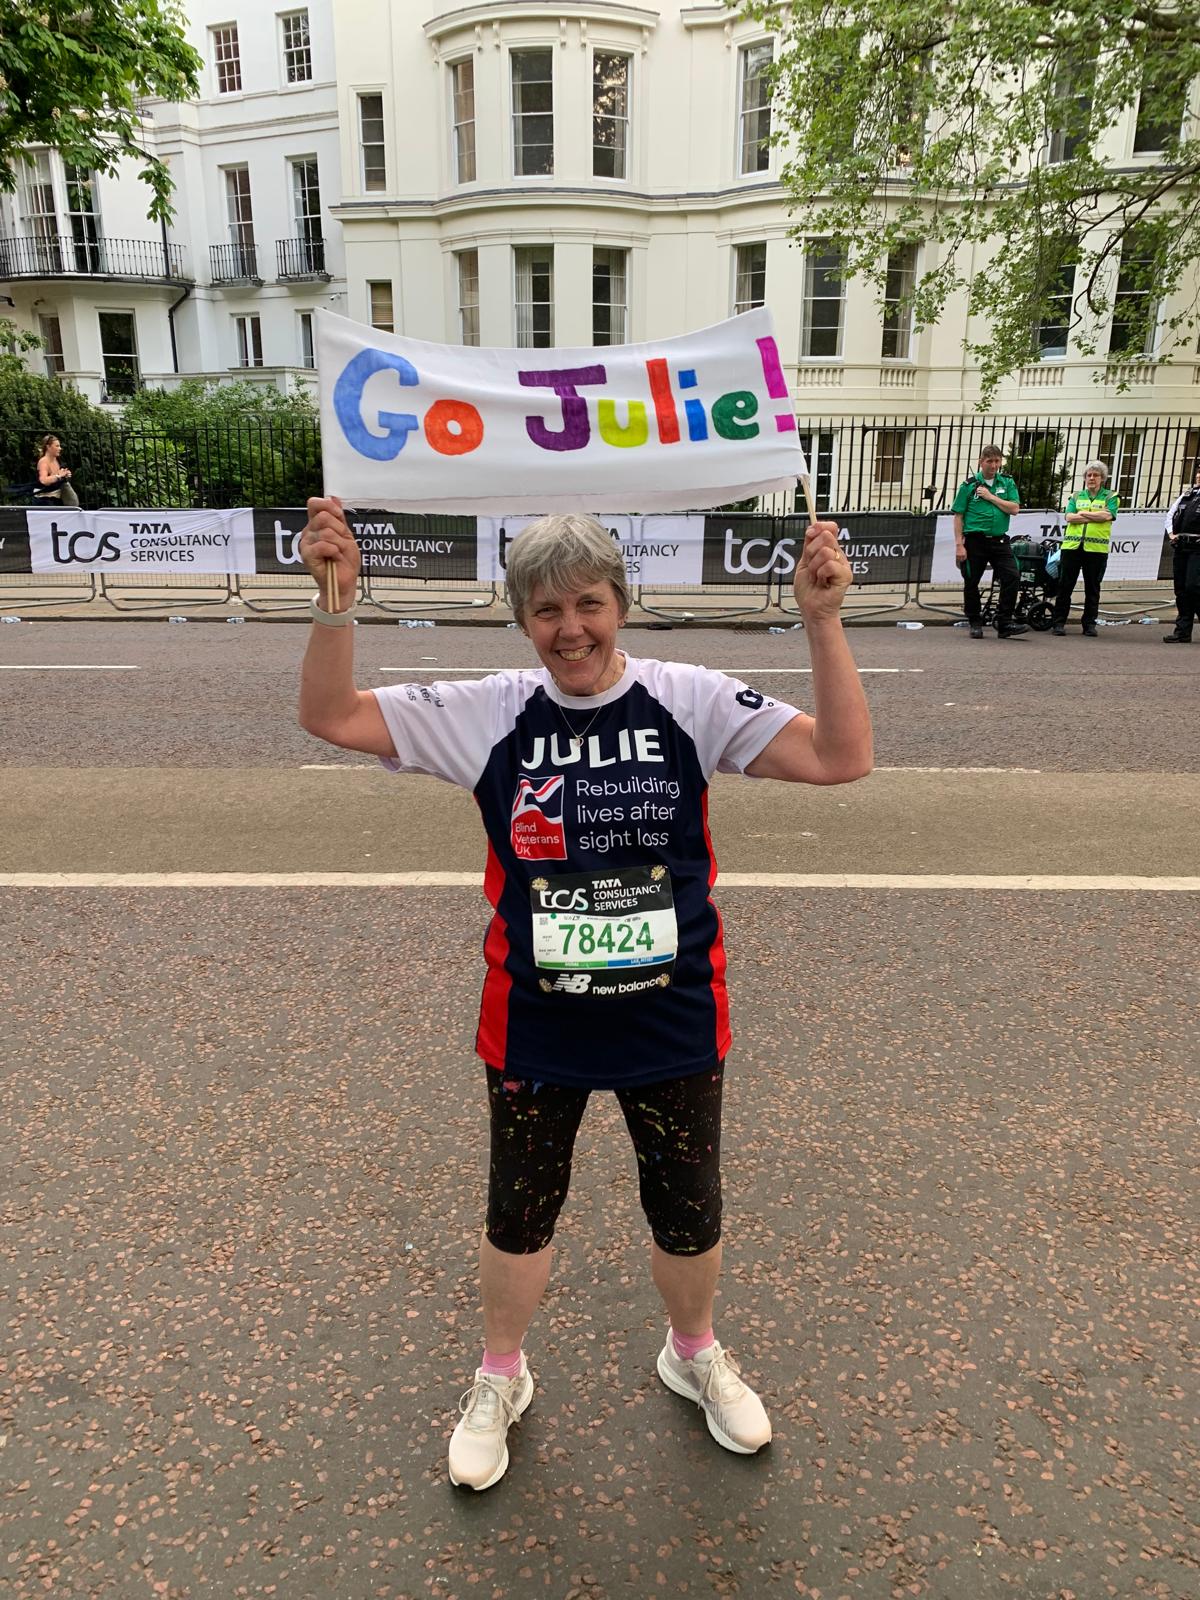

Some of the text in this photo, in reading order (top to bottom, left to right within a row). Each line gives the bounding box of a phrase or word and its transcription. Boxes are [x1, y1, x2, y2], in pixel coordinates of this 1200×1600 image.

[332, 335, 797, 462] Go Julie!
[129, 522, 172, 535] TATA
[352, 522, 397, 535] TATA
[51, 521, 121, 564] tcs
[130, 533, 231, 548] CONSULTANCY
[130, 550, 195, 563] SERVICES
[723, 528, 797, 575] tcs
[839, 543, 911, 557] ULTANCY
[361, 553, 418, 569] ERVICES
[521, 728, 665, 770] JULIE
[576, 776, 680, 798] Rebuilding
[577, 801, 676, 824] lives after
[514, 822, 537, 833] Blind
[514, 834, 560, 845] Veterans
[579, 828, 669, 853] sight loss
[514, 844, 531, 856] UK
[591, 878, 623, 889] TATA
[539, 887, 589, 911] tcs
[592, 884, 662, 901] CONSULTANCY
[593, 897, 639, 912] SERVICES
[558, 921, 655, 955] 78424
[592, 985, 617, 996] new
